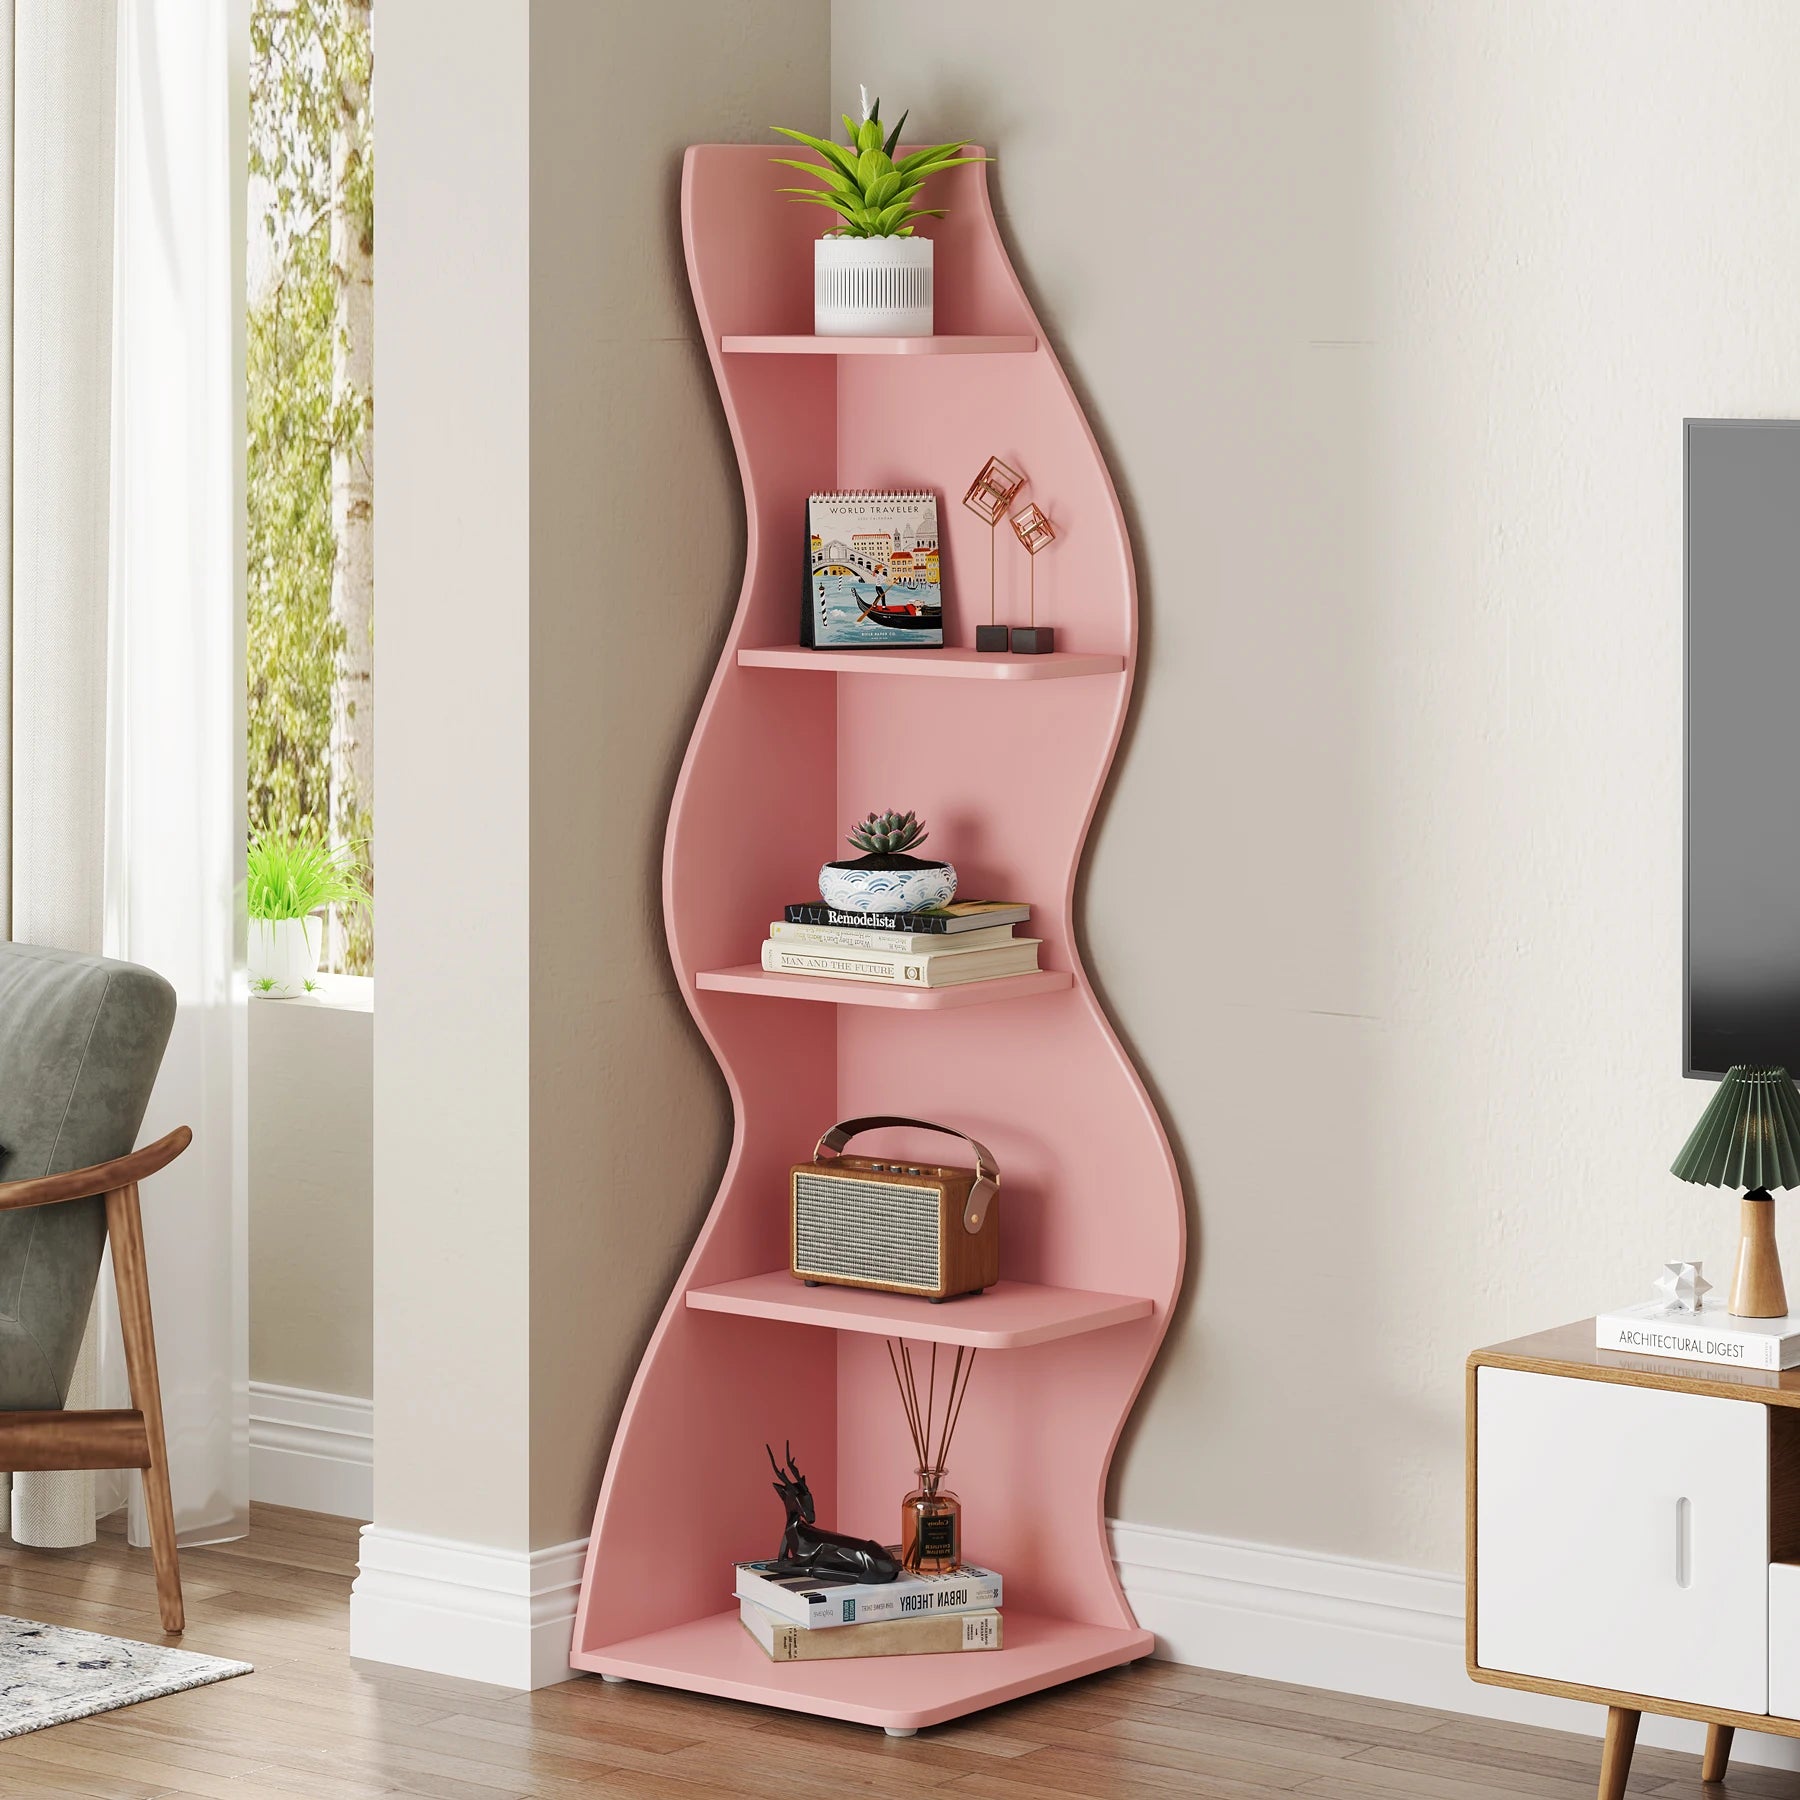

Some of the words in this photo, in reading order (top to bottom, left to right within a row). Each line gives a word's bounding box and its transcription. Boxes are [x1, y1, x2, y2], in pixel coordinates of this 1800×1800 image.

[829, 507, 866, 515] WORLD
[870, 505, 920, 514] TRAVELER
[827, 909, 897, 929] Remodelista
[824, 935, 839, 944] Don't
[839, 936, 854, 946] They
[855, 938, 871, 949] What
[781, 955, 804, 966] MAN
[804, 959, 829, 969] AND
[830, 961, 854, 971] THE
[855, 963, 895, 975] FUTURE
[1619, 1330, 1704, 1354] ARCHITECTURAL
[1706, 1341, 1745, 1359] DIGEST
